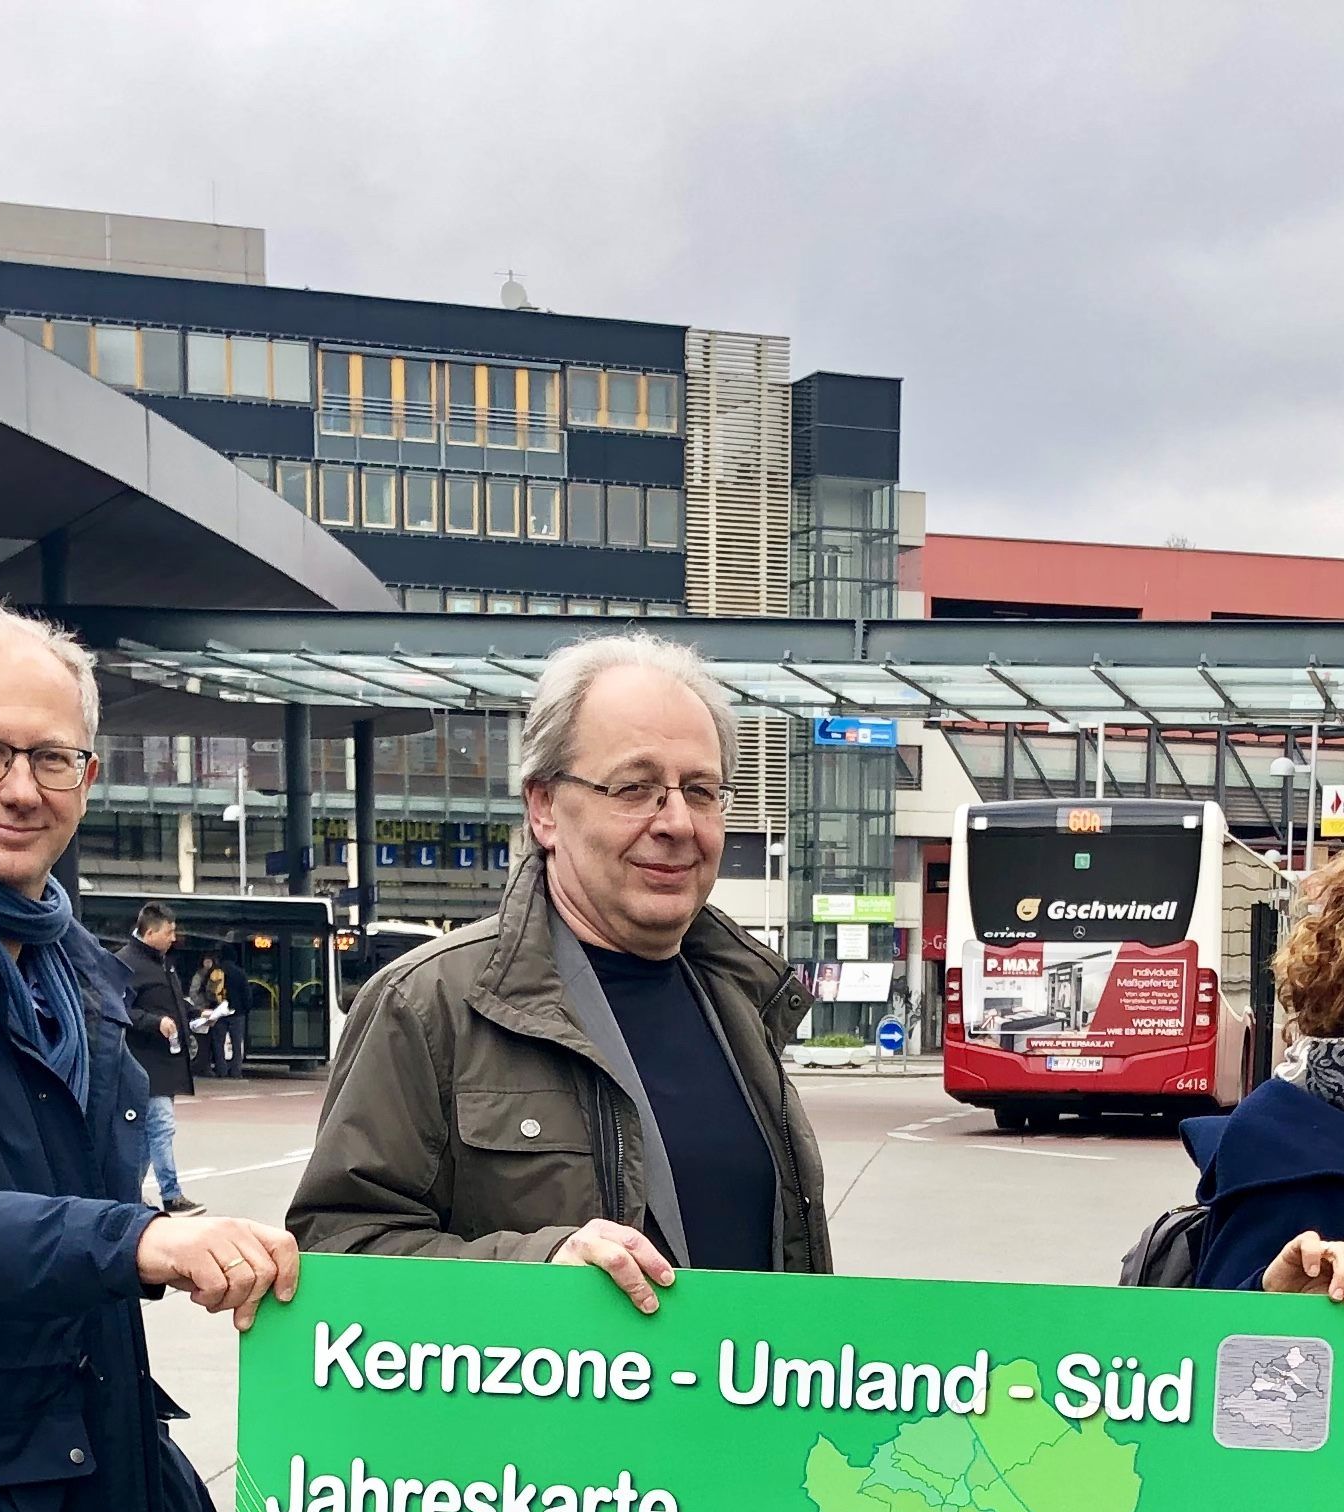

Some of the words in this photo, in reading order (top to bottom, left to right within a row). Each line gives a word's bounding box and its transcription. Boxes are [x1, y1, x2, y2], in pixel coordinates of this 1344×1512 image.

[1047, 900, 1178, 921] Gschwindl
[1132, 1018, 1184, 1027] WOHNEN
[1107, 1028, 1123, 1036] WIE
[1031, 1040, 1115, 1048] WWW.PETERMAX.AT
[1176, 1078, 1208, 1091] 6418
[312, 1320, 652, 1401] Kernzone
[718, 1338, 989, 1416] Umland
[1054, 1352, 1194, 1424] Süd
